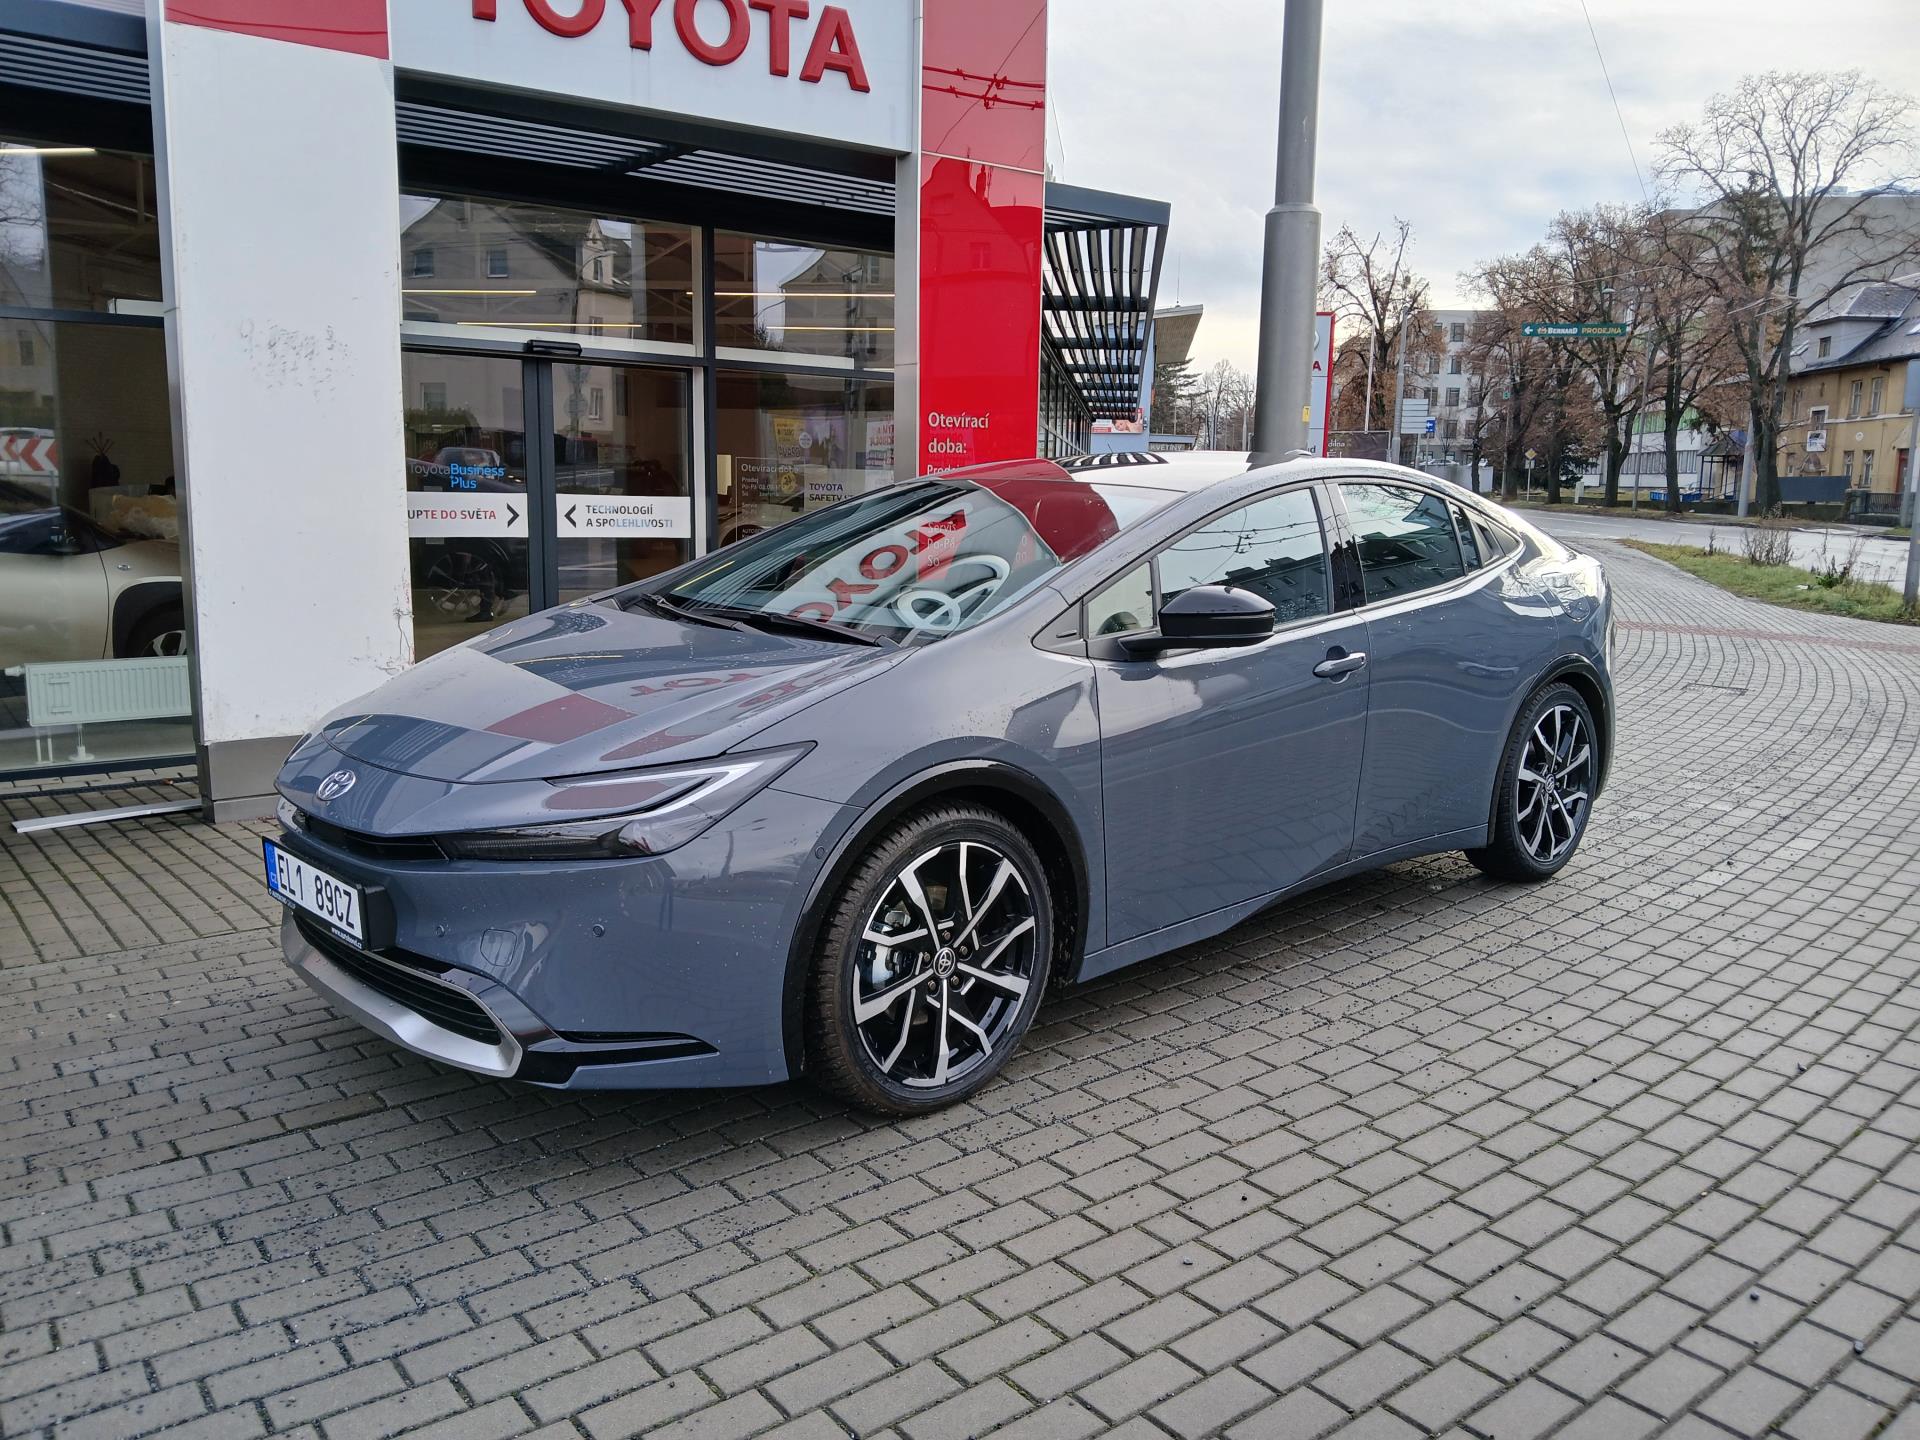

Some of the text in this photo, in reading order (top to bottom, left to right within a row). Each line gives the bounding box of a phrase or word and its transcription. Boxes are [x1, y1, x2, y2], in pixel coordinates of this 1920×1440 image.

[928, 411, 990, 429] Otevírací
[928, 438, 967, 454] doba:
[451, 475, 477, 489] Plus
[809, 483, 843, 492] TOYOTA
[441, 510, 457, 520] DO
[460, 508, 497, 520] SVĚTA
[585, 504, 653, 515] TECHNOLOGIÍ
[586, 518, 673, 528] A SPOLEHLIVOSTI
[277, 853, 304, 901] EL1
[314, 875, 354, 930] 89CZ
